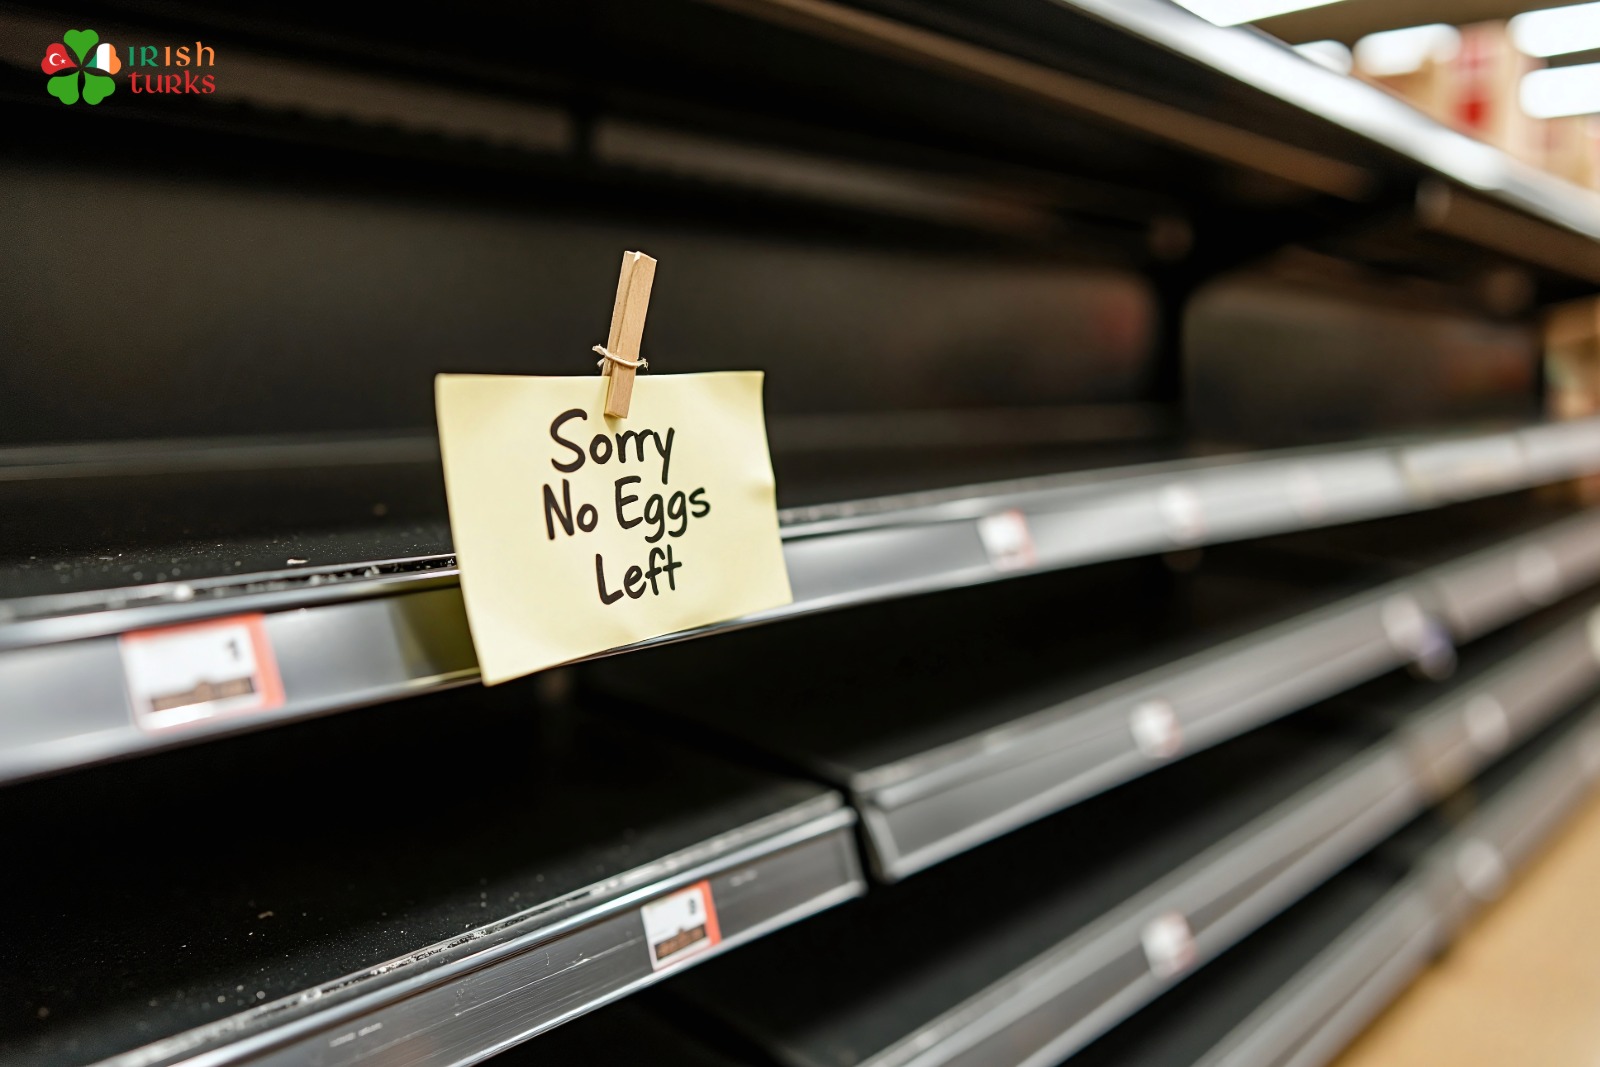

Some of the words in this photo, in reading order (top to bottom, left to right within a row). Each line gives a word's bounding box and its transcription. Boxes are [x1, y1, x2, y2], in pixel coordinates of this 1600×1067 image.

[549, 408, 676, 486] Sorry
[542, 478, 599, 541] No
[614, 475, 711, 544] Eggs
[595, 544, 683, 606] Left
